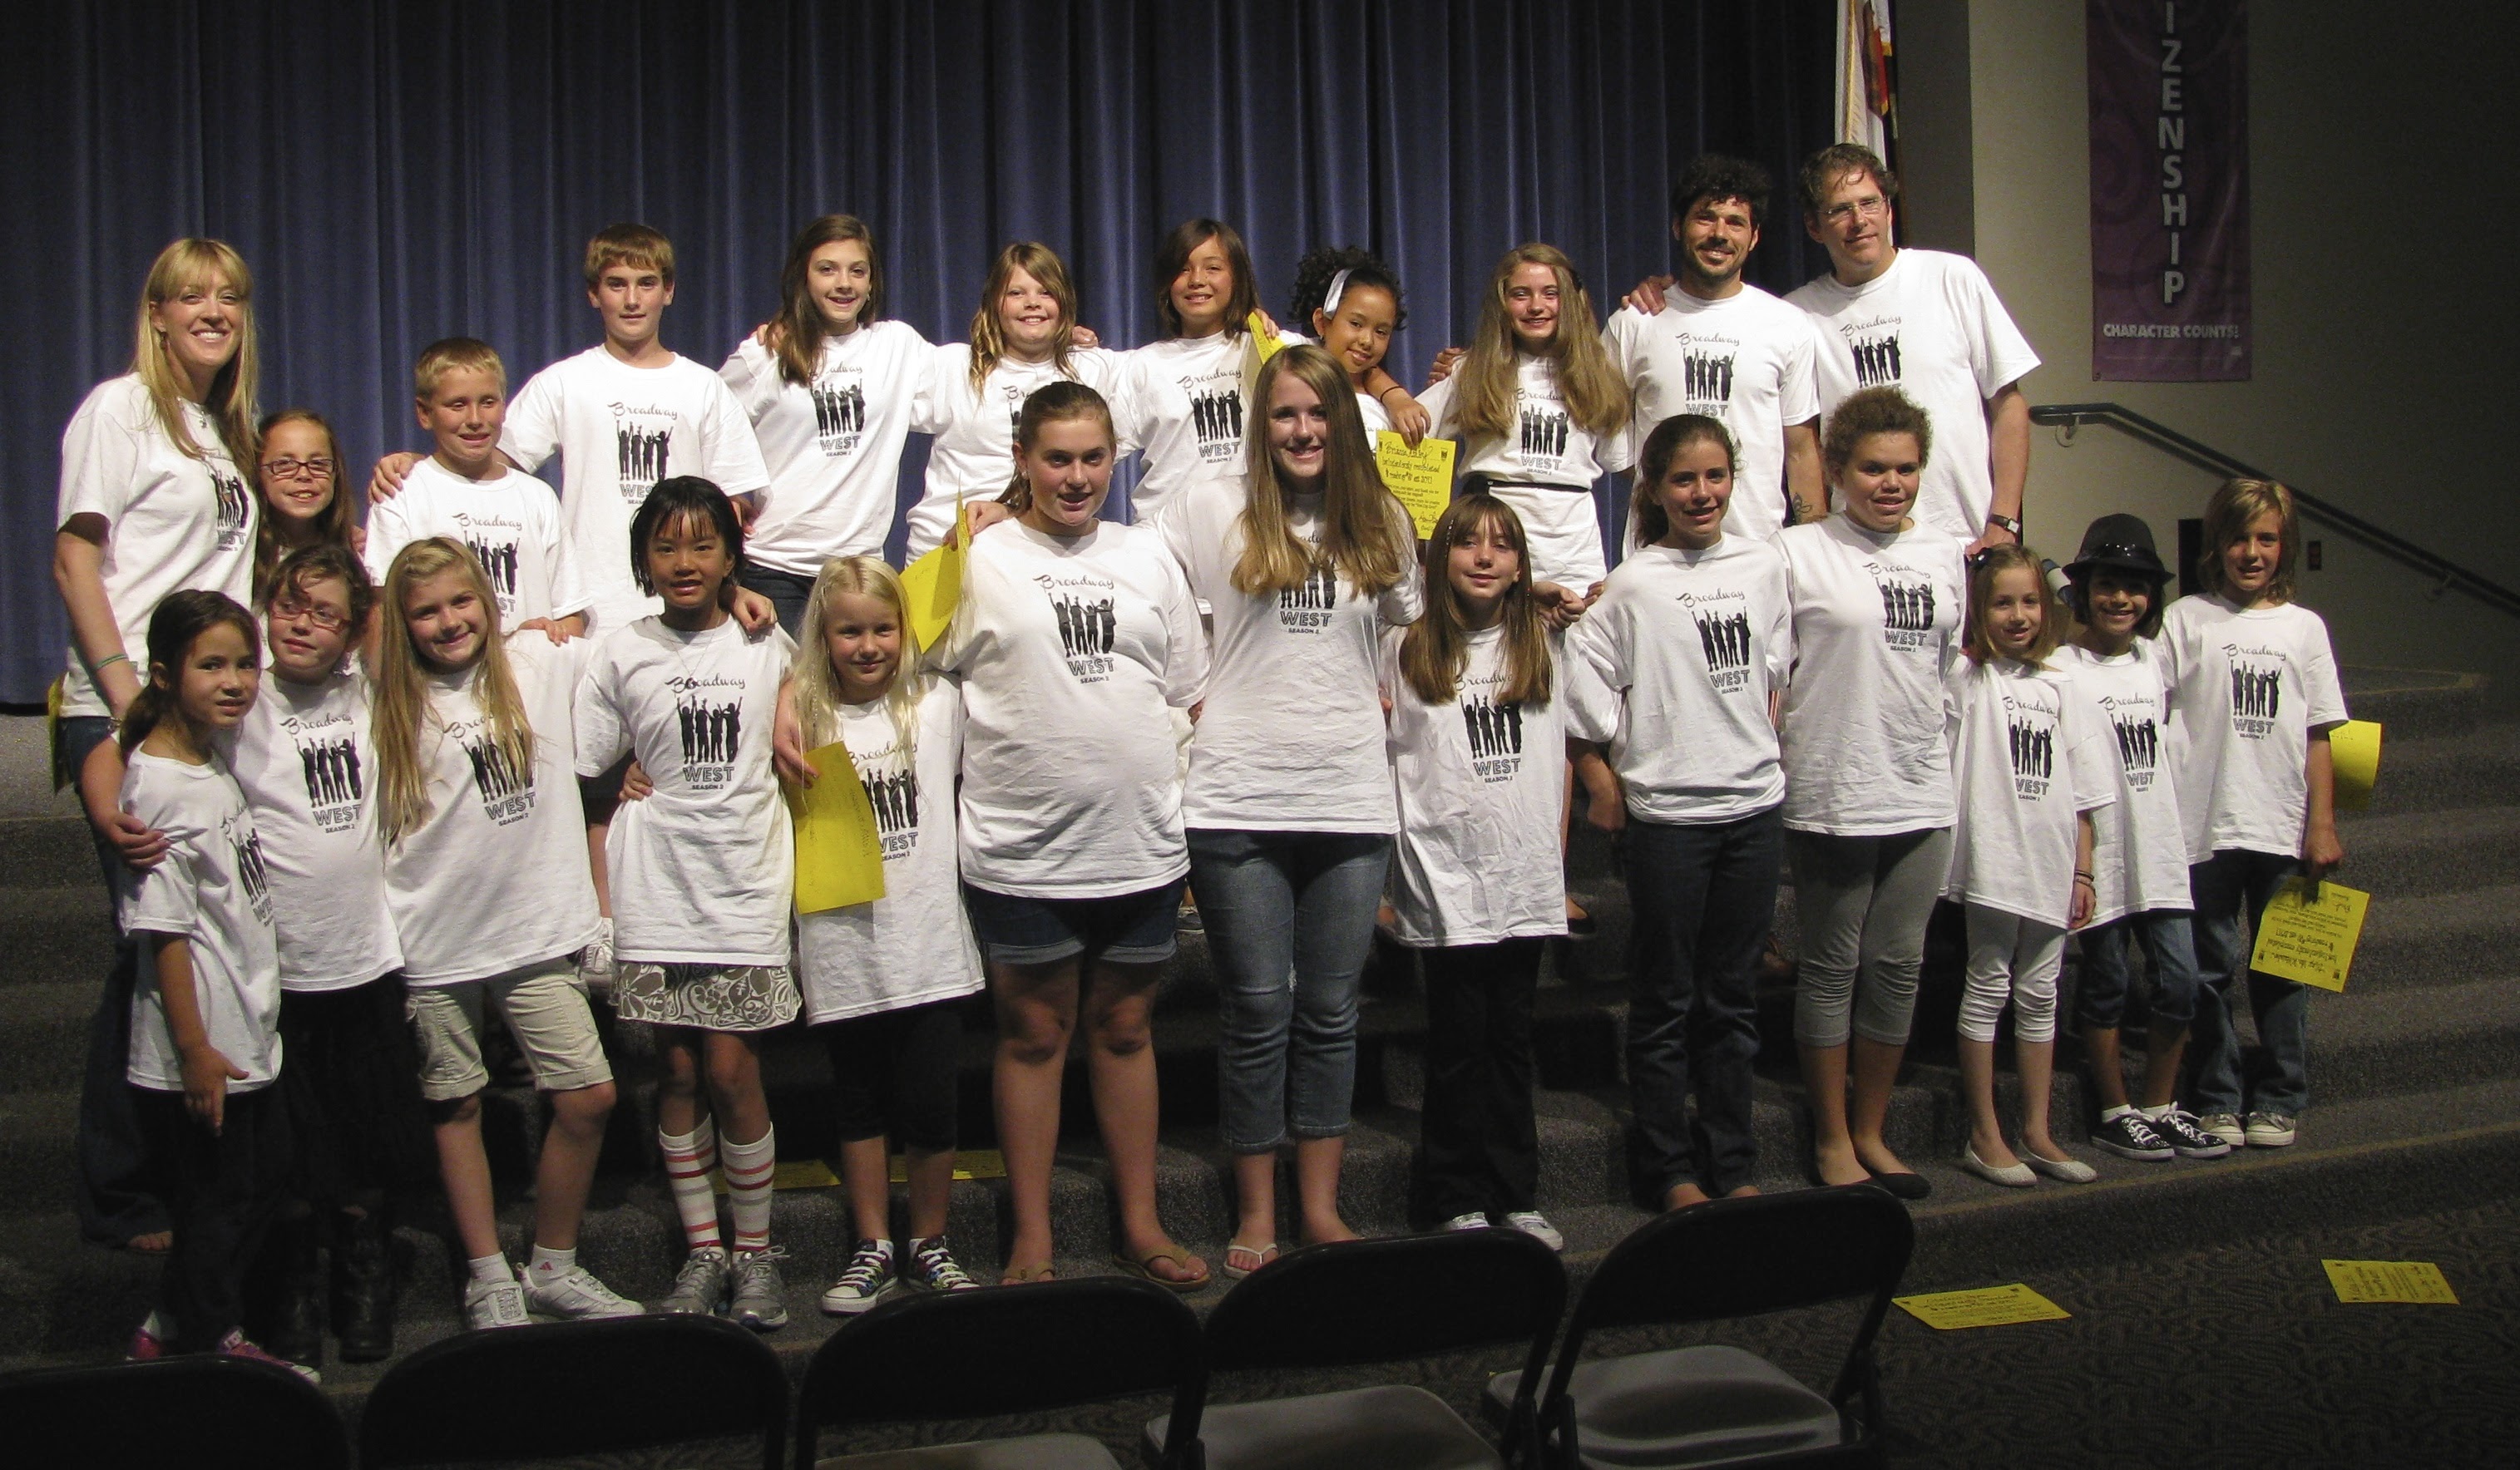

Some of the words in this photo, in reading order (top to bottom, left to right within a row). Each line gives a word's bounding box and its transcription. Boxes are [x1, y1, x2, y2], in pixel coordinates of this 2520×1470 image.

[2157, 1, 2189, 304] IZENSHIP
[1840, 315, 1902, 338] Broadway
[2102, 323, 2181, 338] CHARACTER
[2183, 324, 2240, 339] COUNTS!
[1675, 333, 1740, 347] Broadway
[1176, 369, 1242, 389] Broadway
[1516, 387, 1564, 401] Broadw
[607, 402, 678, 421] Broadway
[1686, 403, 1728, 417] WEST
[819, 435, 862, 451] WEST
[1198, 441, 1241, 458] WEST
[1520, 455, 1563, 471] WEST
[620, 484, 654, 498] WES
[452, 513, 522, 531] Broadway
[1032, 575, 1114, 591] Broadway
[499, 597, 516, 613] ST
[1675, 588, 1745, 609] Broadway
[1279, 610, 1332, 627] WEST
[1885, 629, 1927, 646] WEST
[2221, 644, 2286, 661] Broadway
[1068, 658, 1114, 677] WEST
[665, 672, 746, 695] Boadway
[1455, 671, 1513, 691] Broadw
[1710, 669, 1751, 688] WEST
[2097, 693, 2155, 713] Broadway
[279, 713, 354, 736] Broadway
[2232, 718, 2275, 734] WEST
[683, 767, 734, 782] WEST
[1473, 757, 1521, 777] WEST
[313, 804, 361, 826] WEST
[485, 792, 536, 821] WEST
[499, 814, 523, 826] SEASON
